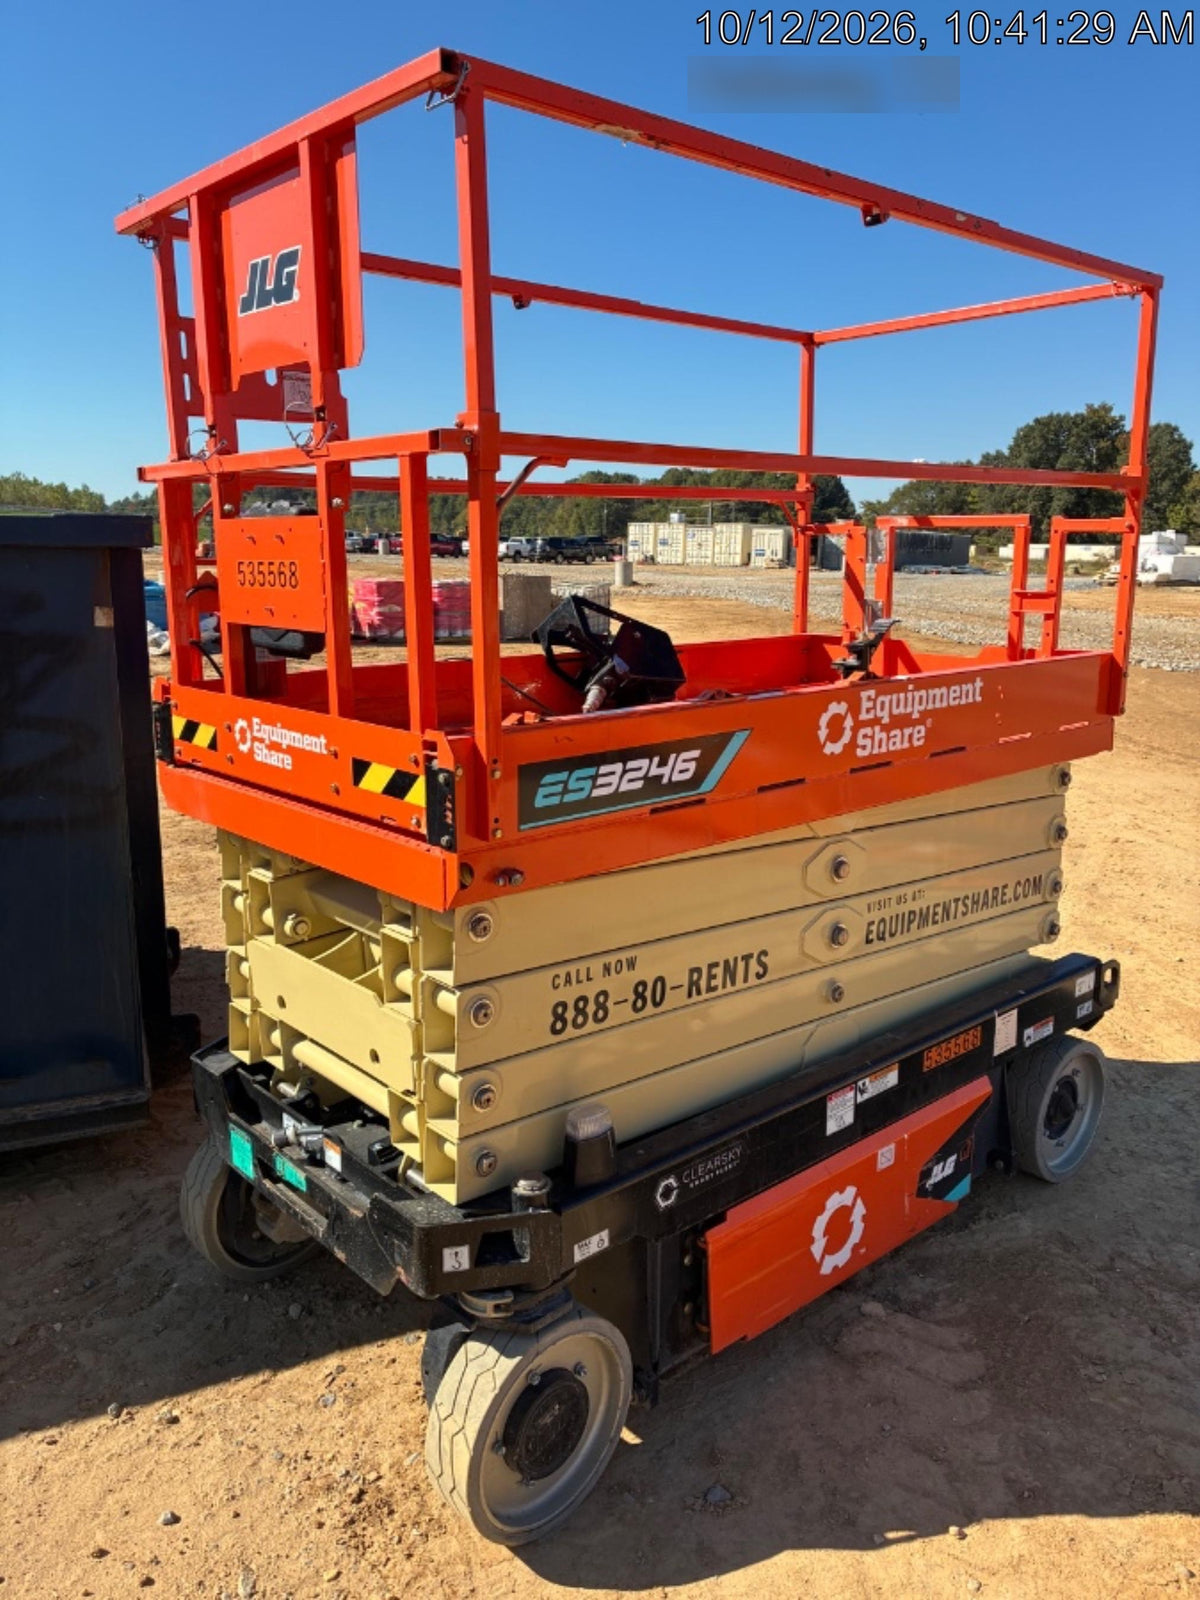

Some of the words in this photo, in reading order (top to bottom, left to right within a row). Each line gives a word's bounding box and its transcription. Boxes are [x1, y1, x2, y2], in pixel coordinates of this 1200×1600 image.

[238, 245, 302, 317] JLG
[237, 561, 299, 589] 535568
[858, 676, 984, 724] Equipment
[252, 717, 328, 755] Equipment
[856, 724, 926, 758] Share
[254, 741, 292, 771] Share
[534, 749, 702, 809] ES3246
[865, 874, 1043, 945] EQUIPMENTSHARE.COM
[867, 897, 892, 914] VISIT
[895, 891, 908, 906] US
[552, 966, 594, 990] CALL
[602, 955, 638, 978] NOW
[550, 949, 769, 1035] 888-80-RENTS
[923, 1026, 980, 1068] 535568
[682, 1145, 742, 1183] CLEARSKY
